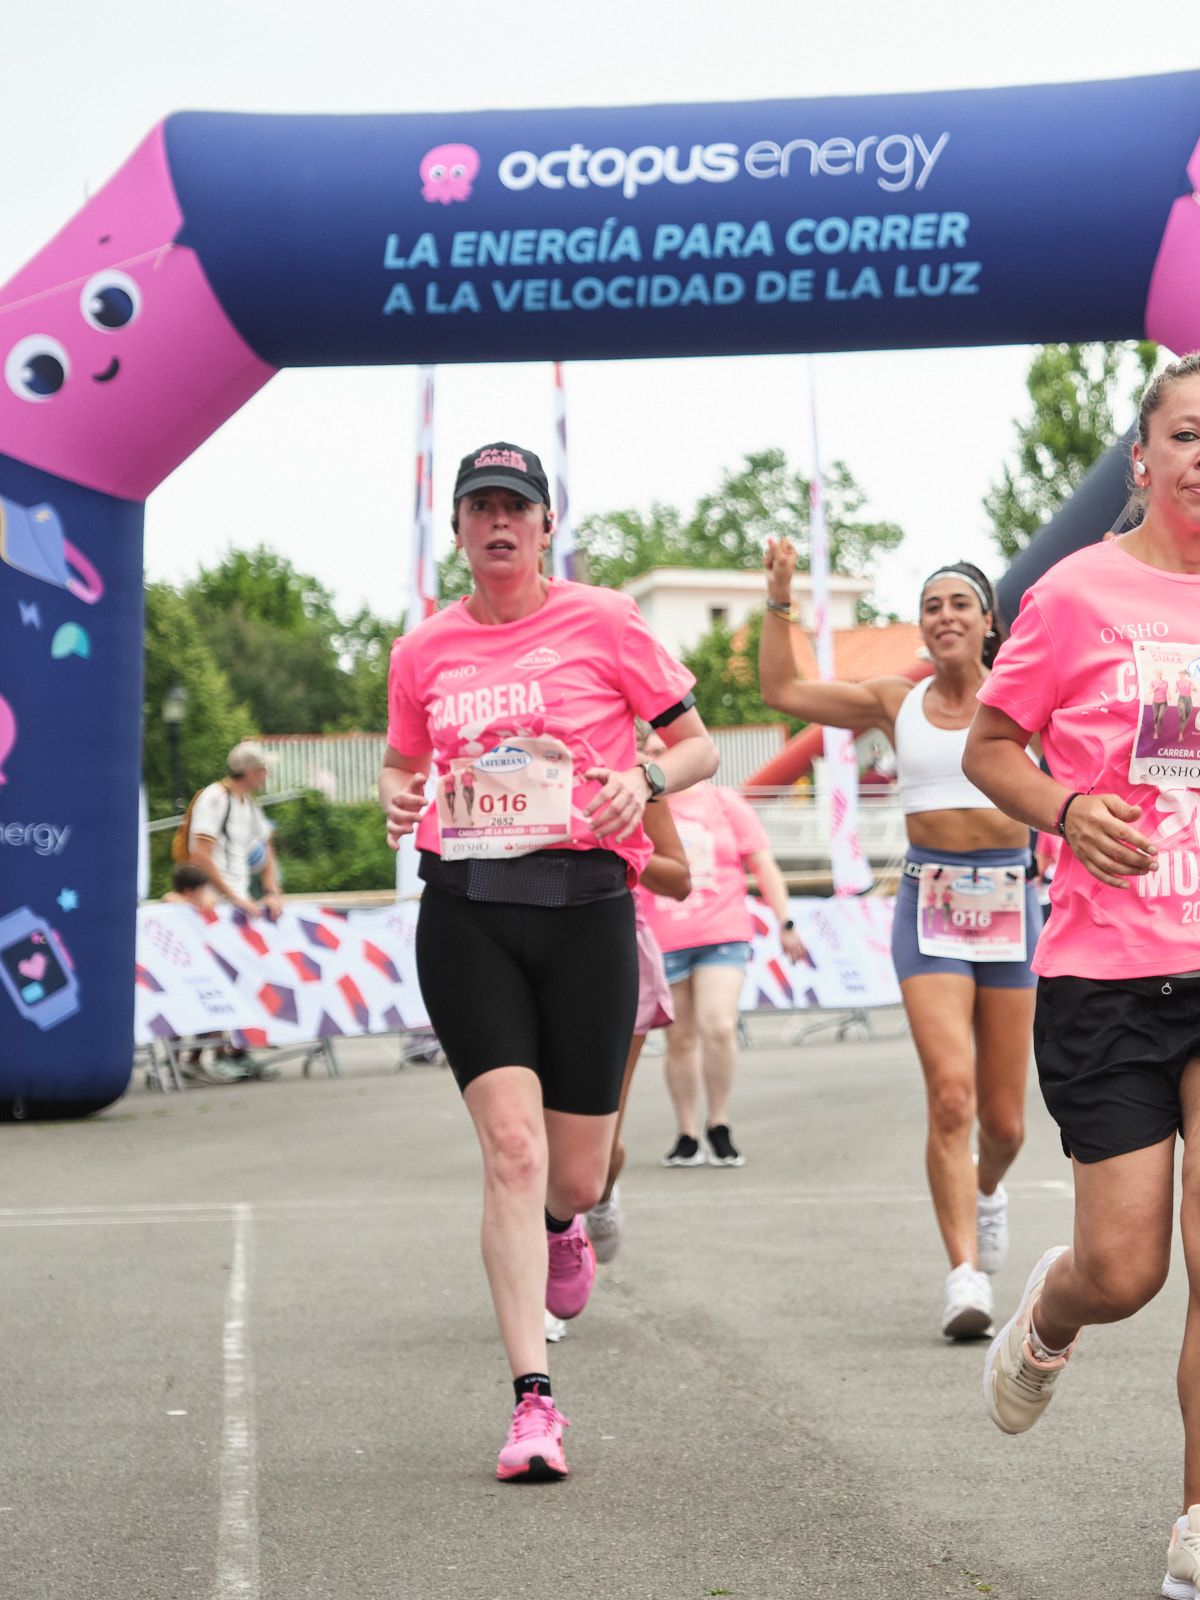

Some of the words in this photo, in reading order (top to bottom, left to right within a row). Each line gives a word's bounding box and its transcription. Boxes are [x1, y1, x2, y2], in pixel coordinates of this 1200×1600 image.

[498, 142, 740, 199] octopus
[744, 131, 951, 193] energy
[383, 231, 440, 270] LA
[450, 216, 642, 268] ENERGÍA
[652, 219, 775, 261] PARA
[785, 211, 971, 255] CORRER
[382, 283, 414, 315] A
[425, 280, 482, 314] LA
[493, 271, 746, 312] VELOCIDAD
[755, 268, 816, 303] DE
[825, 266, 883, 299] LA
[894, 261, 983, 297] LUZ
[1100, 621, 1169, 645] OYSHO
[432, 680, 547, 730] CARRERA
[479, 757, 528, 768] ASTURIANA
[1157, 748, 1195, 758] CARRERA
[478, 793, 528, 814] 016
[0, 822, 73, 857] ergy
[951, 910, 992, 928] 016
